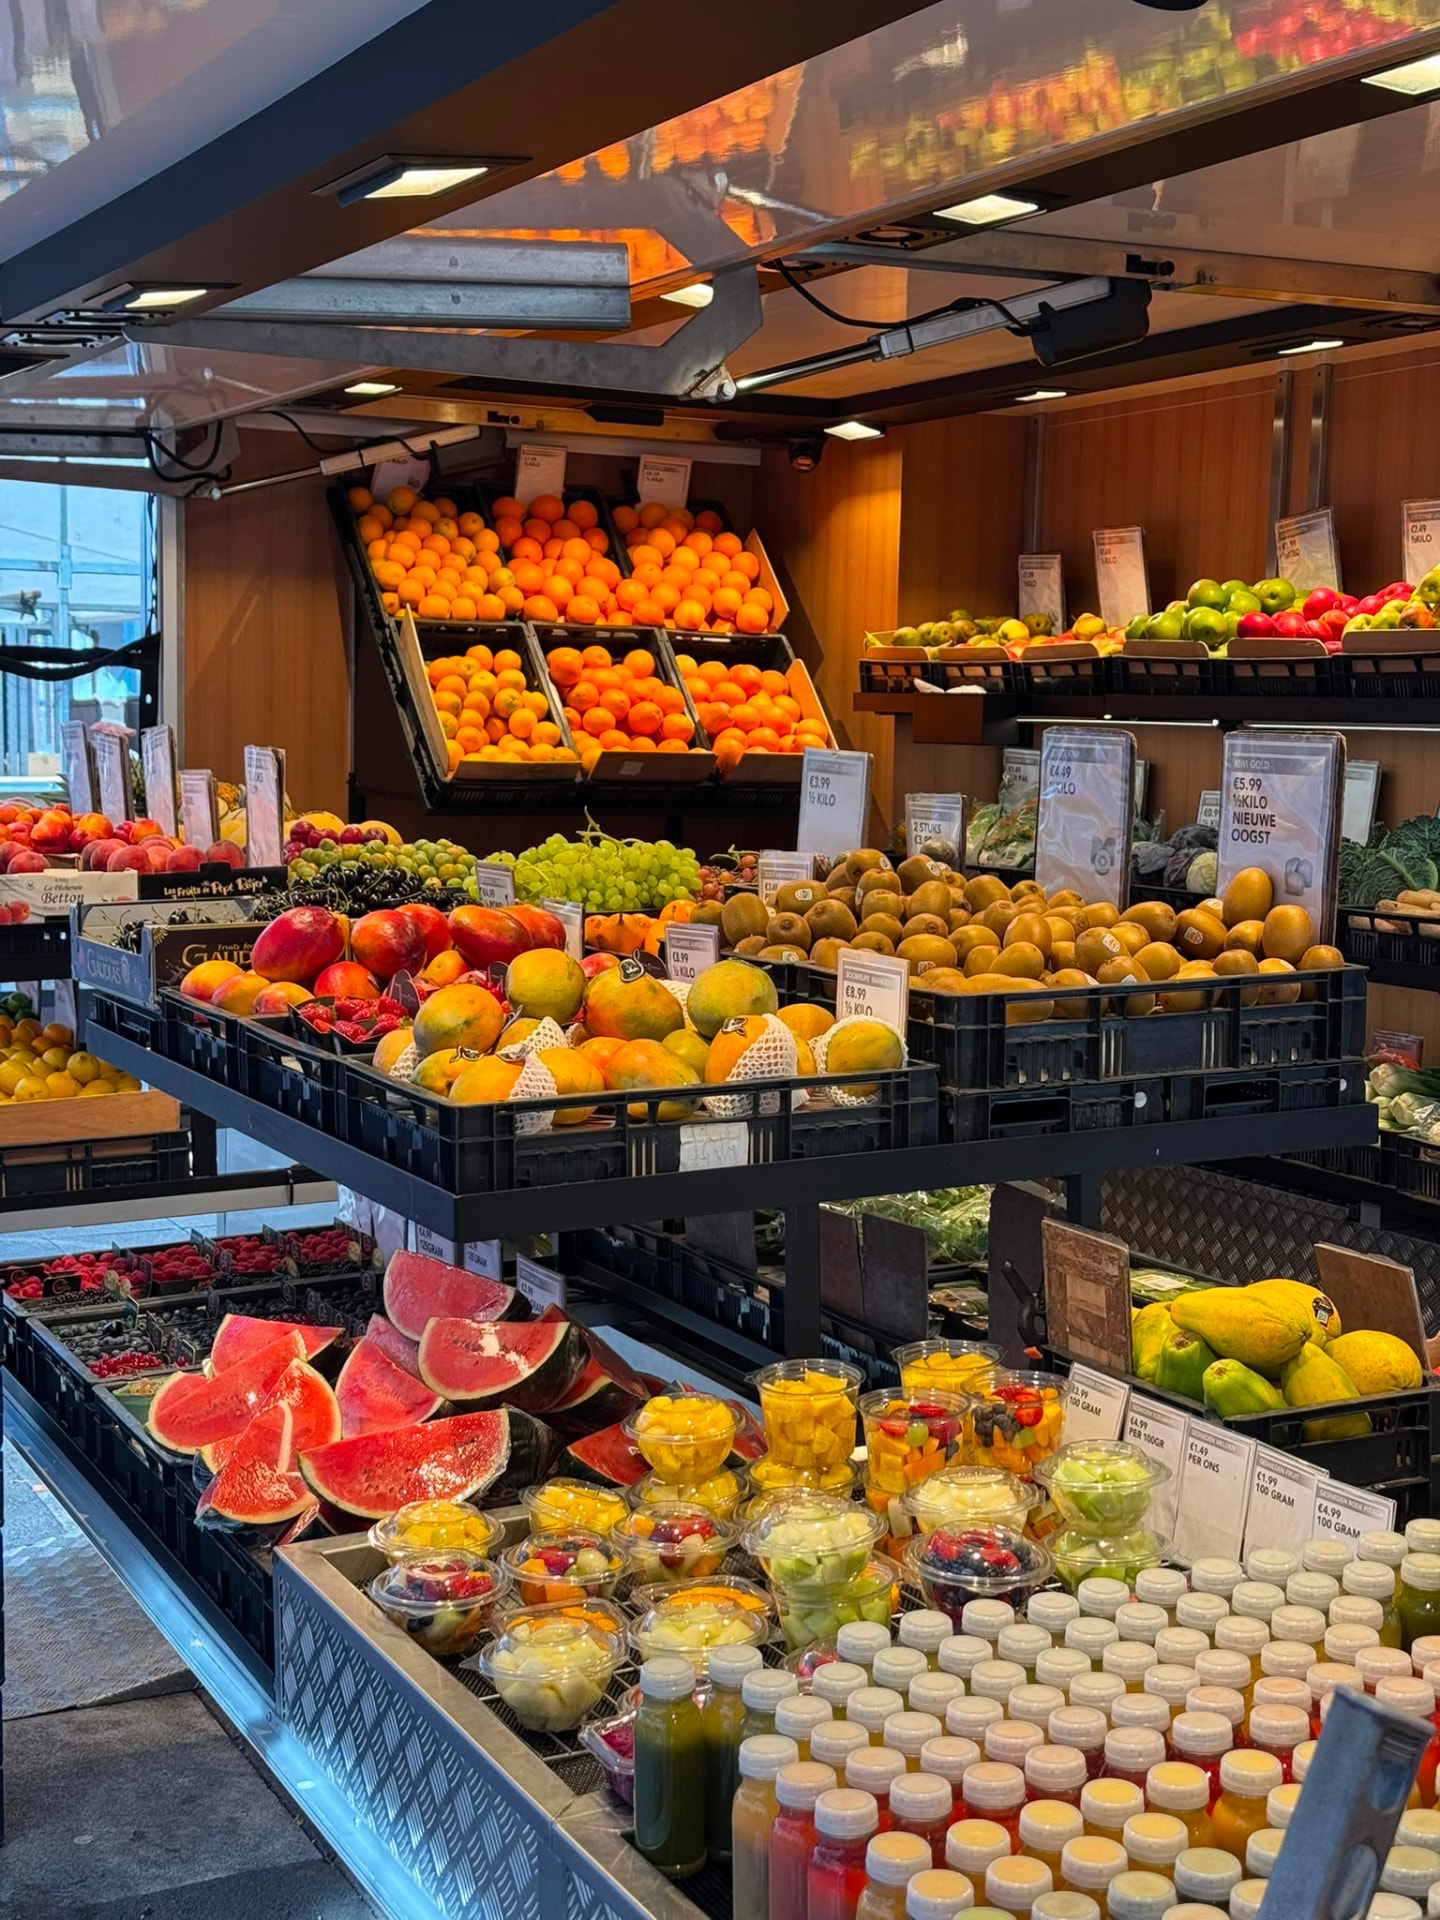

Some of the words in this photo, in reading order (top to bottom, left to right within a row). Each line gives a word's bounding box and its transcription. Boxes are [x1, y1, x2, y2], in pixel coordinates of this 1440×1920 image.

[1050, 765, 1072, 778] €4.49
[1250, 759, 1271, 770] GOLD
[809, 775, 831, 790] €3.99
[1233, 777, 1262, 791] €5.99
[808, 792, 815, 804] ½
[816, 793, 836, 807] KILO
[1232, 811, 1277, 828] NIEUWE
[914, 822, 919, 831] 2
[920, 823, 942, 834] STUKS
[1231, 829, 1271, 844] OOGST
[41, 892, 84, 904] Betton
[673, 951, 689, 963] €8.99
[680, 966, 695, 978] KILO
[846, 985, 866, 1000] €8.99
[845, 1000, 853, 1013] ½
[855, 1003, 873, 1016] KILO
[1070, 1396, 1080, 1407] 100
[1081, 1401, 1101, 1416] GRAM
[1130, 1417, 1147, 1430] €4.99
[1129, 1427, 1141, 1440] PER
[1143, 1433, 1164, 1449] 100GR
[1190, 1442, 1208, 1456] €1.49
[1188, 1453, 1201, 1466] PER
[1203, 1461, 1219, 1473] ONS
[1257, 1471, 1278, 1487] €1.99
[1256, 1483, 1269, 1495] 100
[1271, 1489, 1294, 1508] GRAM
[1320, 1489, 1348, 1504] GESNEDEN
[1318, 1503, 1341, 1519] €4.99
[1318, 1516, 1332, 1529] 100
[1334, 1522, 1360, 1539] GRAM
